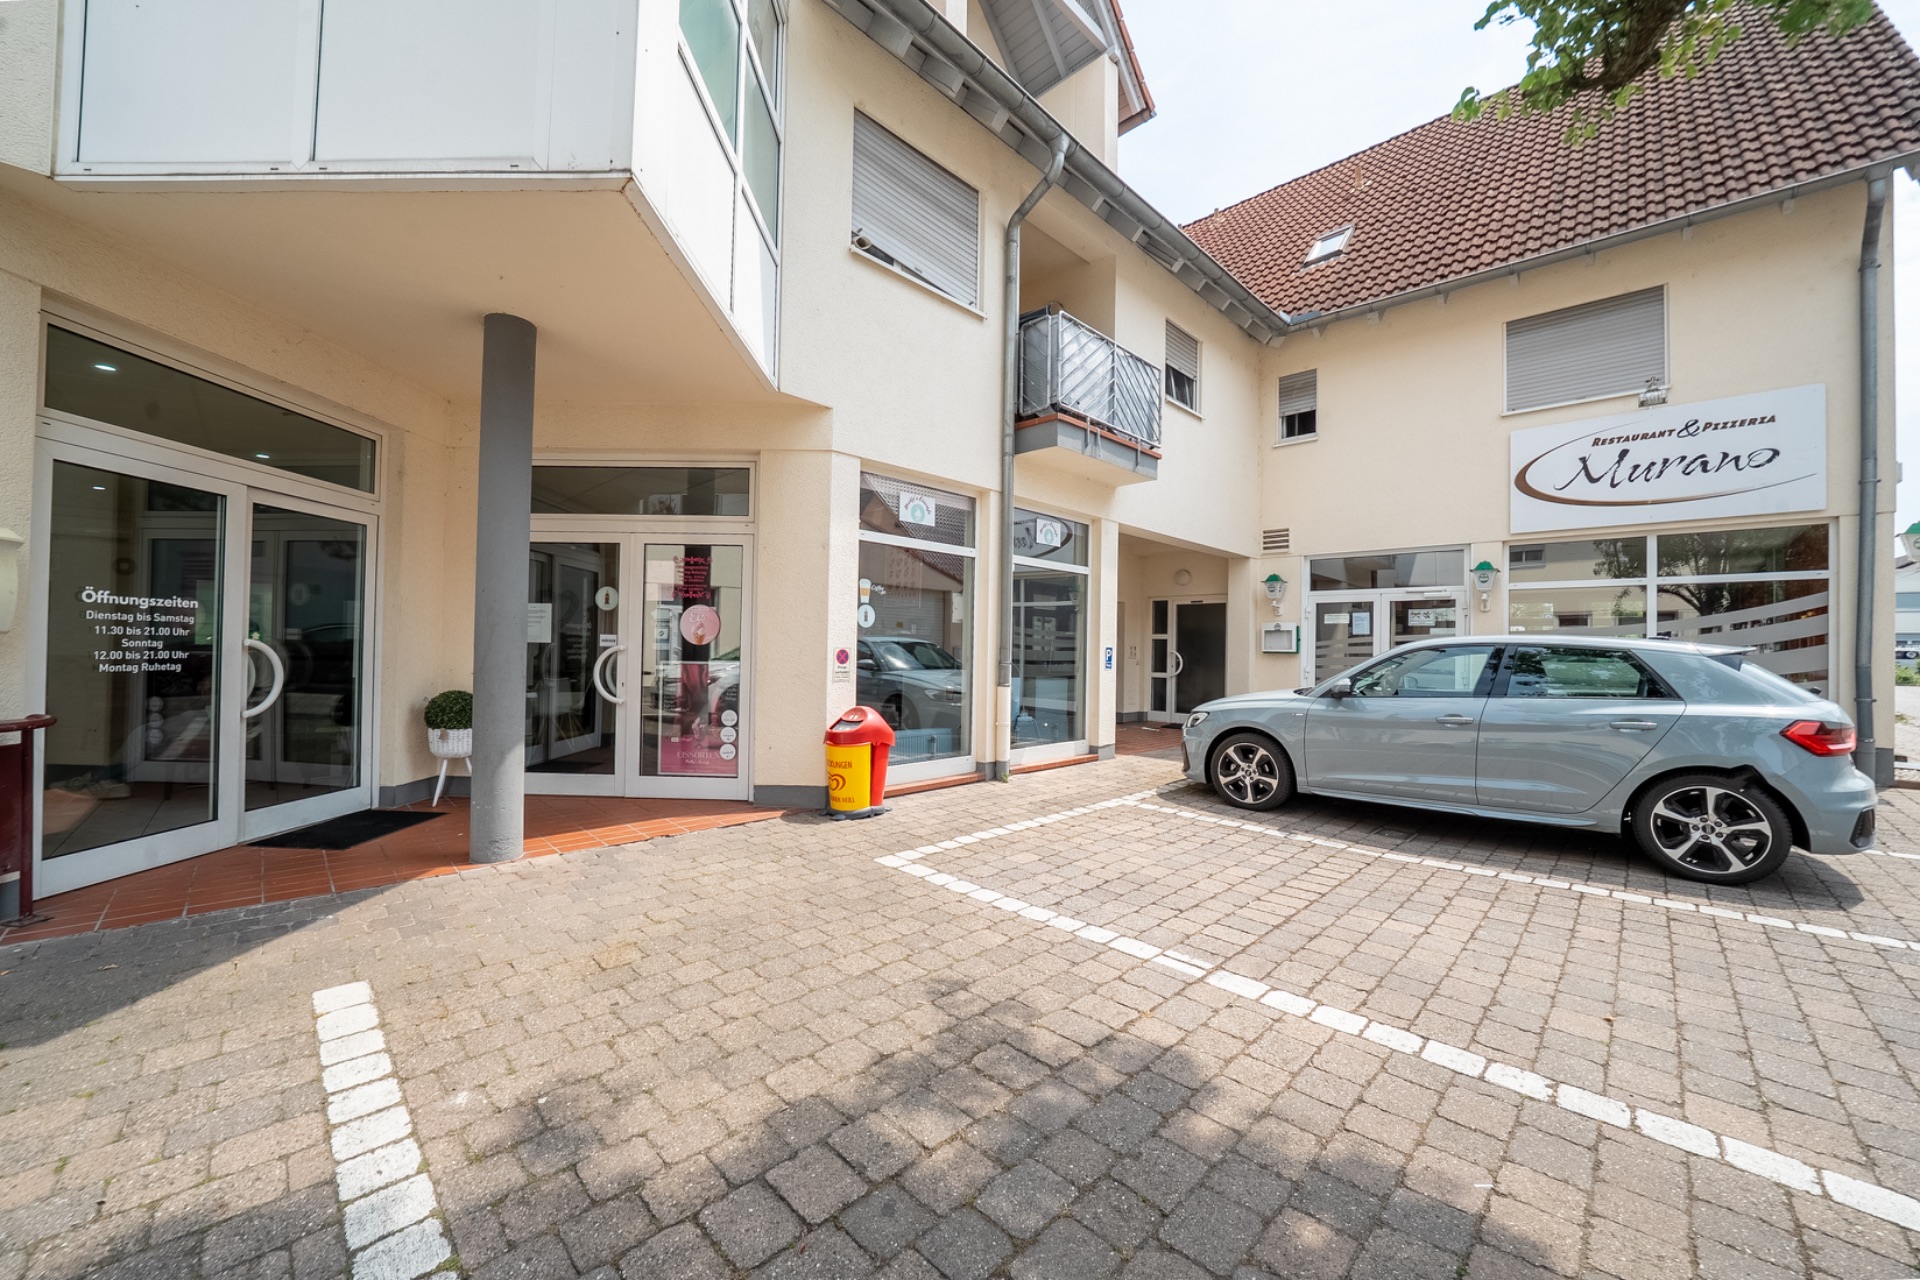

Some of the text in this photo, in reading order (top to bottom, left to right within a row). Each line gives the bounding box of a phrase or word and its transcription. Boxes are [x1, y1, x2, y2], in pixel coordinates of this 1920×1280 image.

[1591, 415, 1776, 447] RESTAURANT & PIZZERIA
[1553, 448, 1781, 491] Murano
[81, 586, 199, 608] Öffnungszeiten
[86, 610, 194, 624] Dienstag bis Samstag
[94, 626, 191, 637] 11.30 bis 21.00 Uhr
[121, 638, 163, 649] Sonntag
[93, 650, 190, 660] 12.00 bis 21.00 Uhr
[98, 662, 182, 673] Montag Ruhetag
